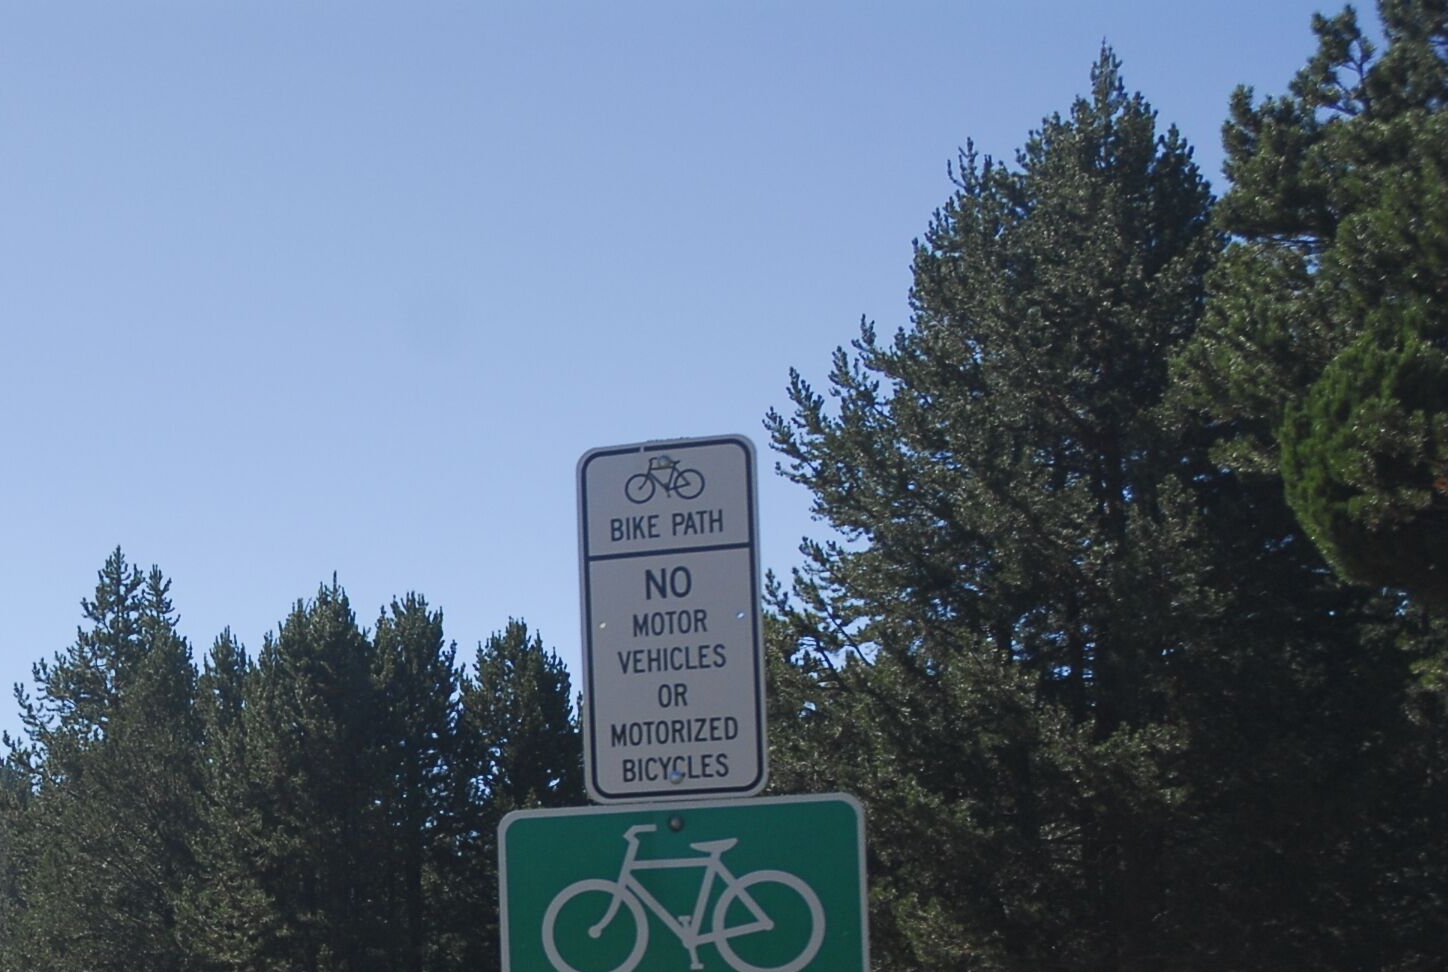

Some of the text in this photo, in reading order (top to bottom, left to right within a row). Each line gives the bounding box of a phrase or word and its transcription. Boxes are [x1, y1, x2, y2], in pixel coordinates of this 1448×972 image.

[610, 508, 724, 542] BIKE PATH
[645, 566, 692, 600] NO
[633, 609, 708, 637] MOTOR
[617, 644, 726, 674] VEHICLES
[658, 684, 688, 708] OR
[611, 717, 738, 748] MOTORIZED
[622, 754, 729, 783] BICYCLES
